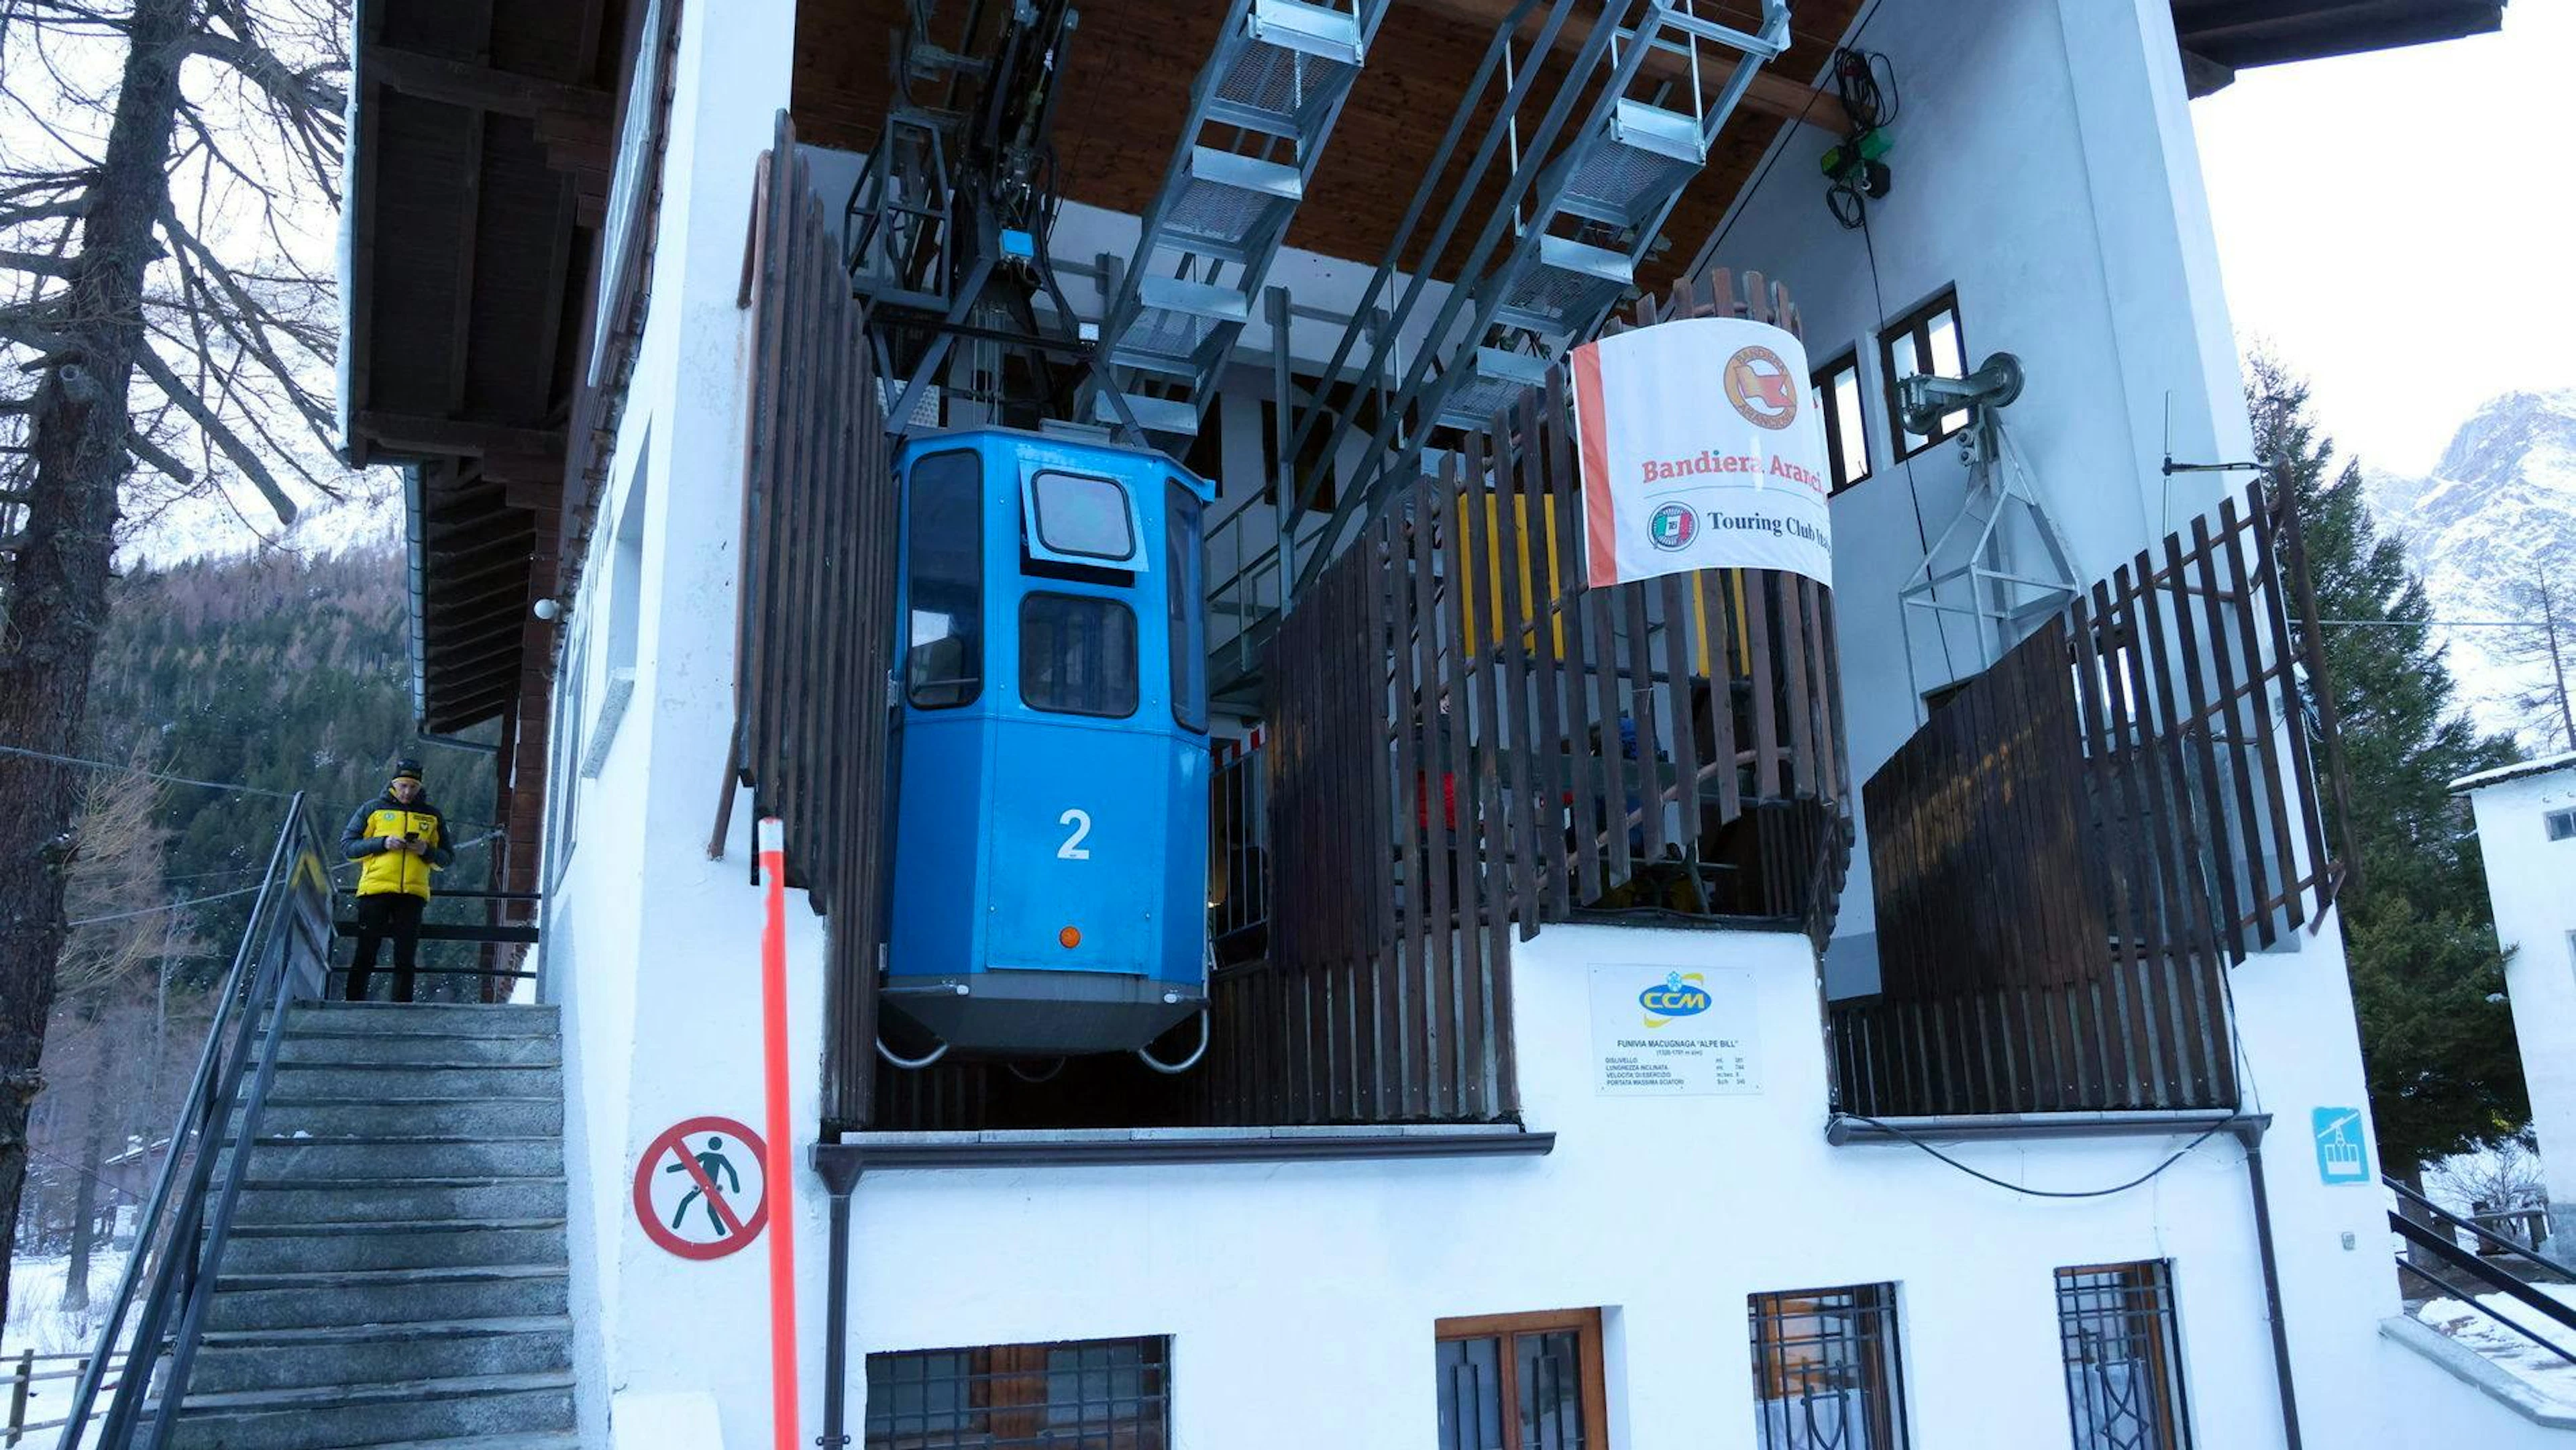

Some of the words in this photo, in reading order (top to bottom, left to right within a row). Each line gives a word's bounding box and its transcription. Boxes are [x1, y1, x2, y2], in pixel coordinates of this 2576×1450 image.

[1642, 450, 1764, 483] Bandiera
[1707, 512, 1782, 537] Touring
[1786, 517, 1815, 541] Club
[1057, 809, 1091, 860] 2
[1644, 992, 1705, 1008] CCM
